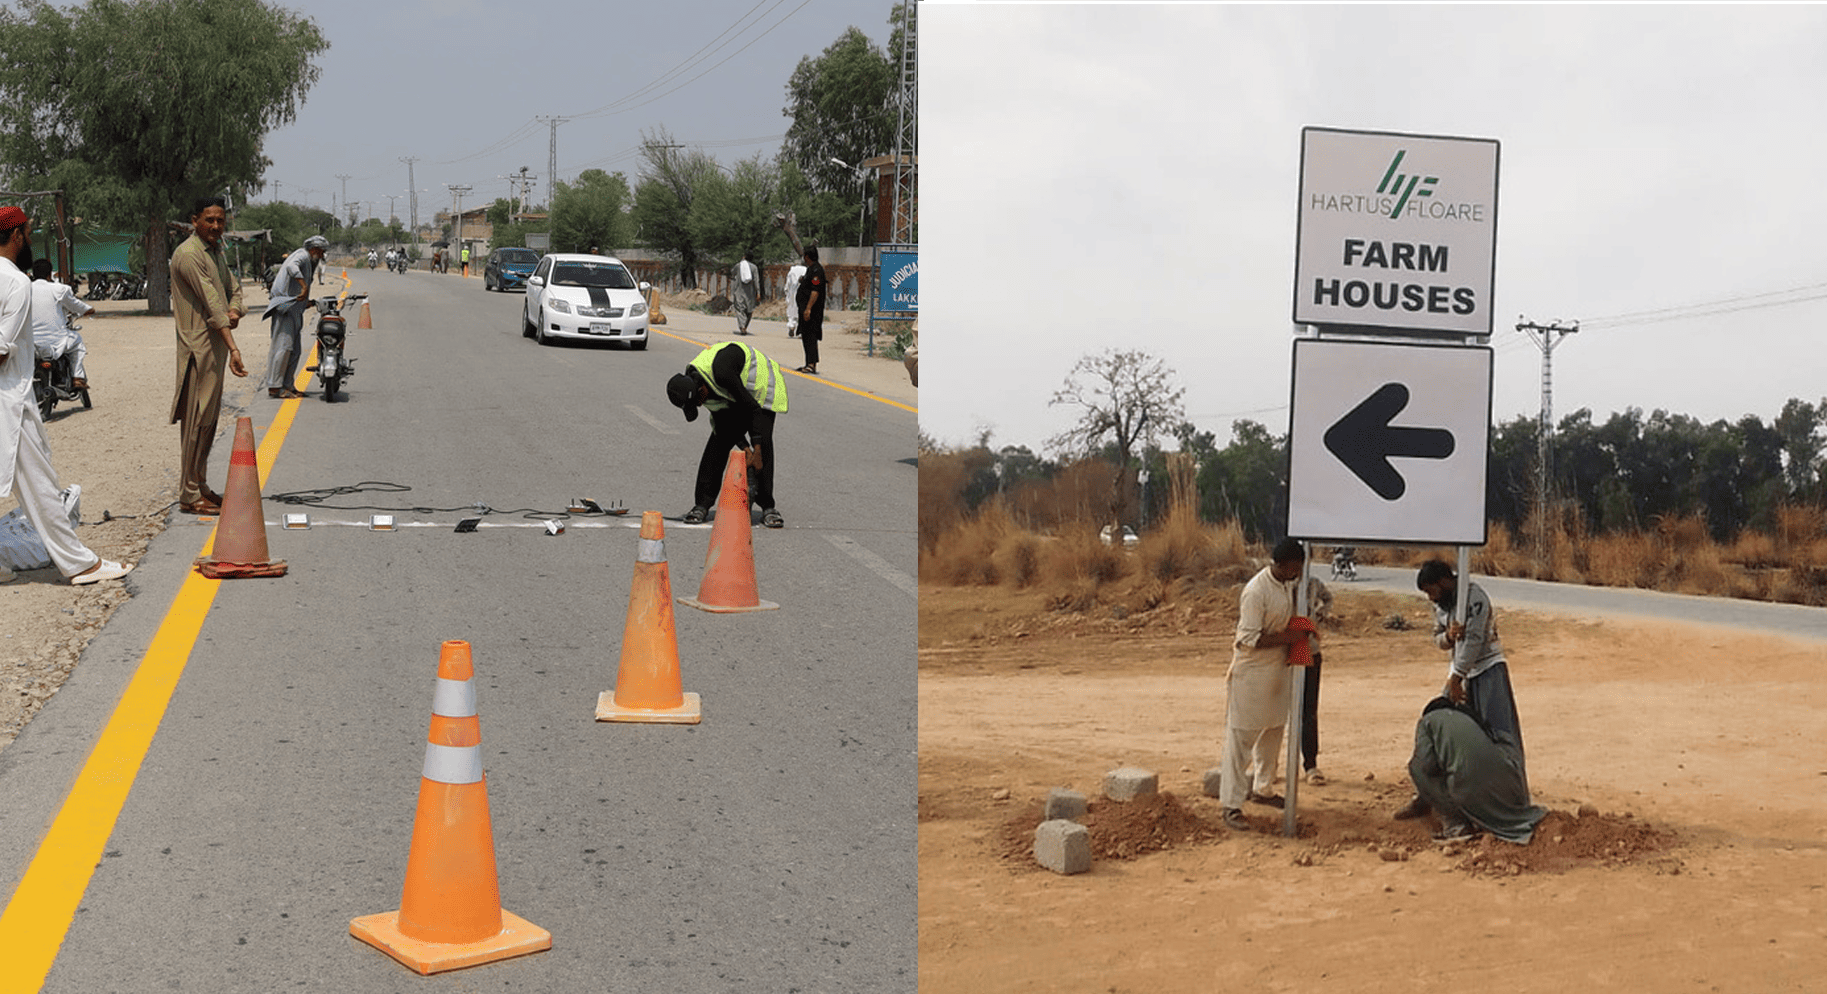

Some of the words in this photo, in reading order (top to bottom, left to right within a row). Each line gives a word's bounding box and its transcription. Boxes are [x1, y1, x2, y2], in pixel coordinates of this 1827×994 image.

[1311, 193, 1393, 216] HARTUS
[1407, 200, 1485, 222] FLOARE
[1343, 239, 1448, 272] FARM
[889, 261, 918, 289] JUDICIA
[1314, 278, 1475, 315] HOUSES
